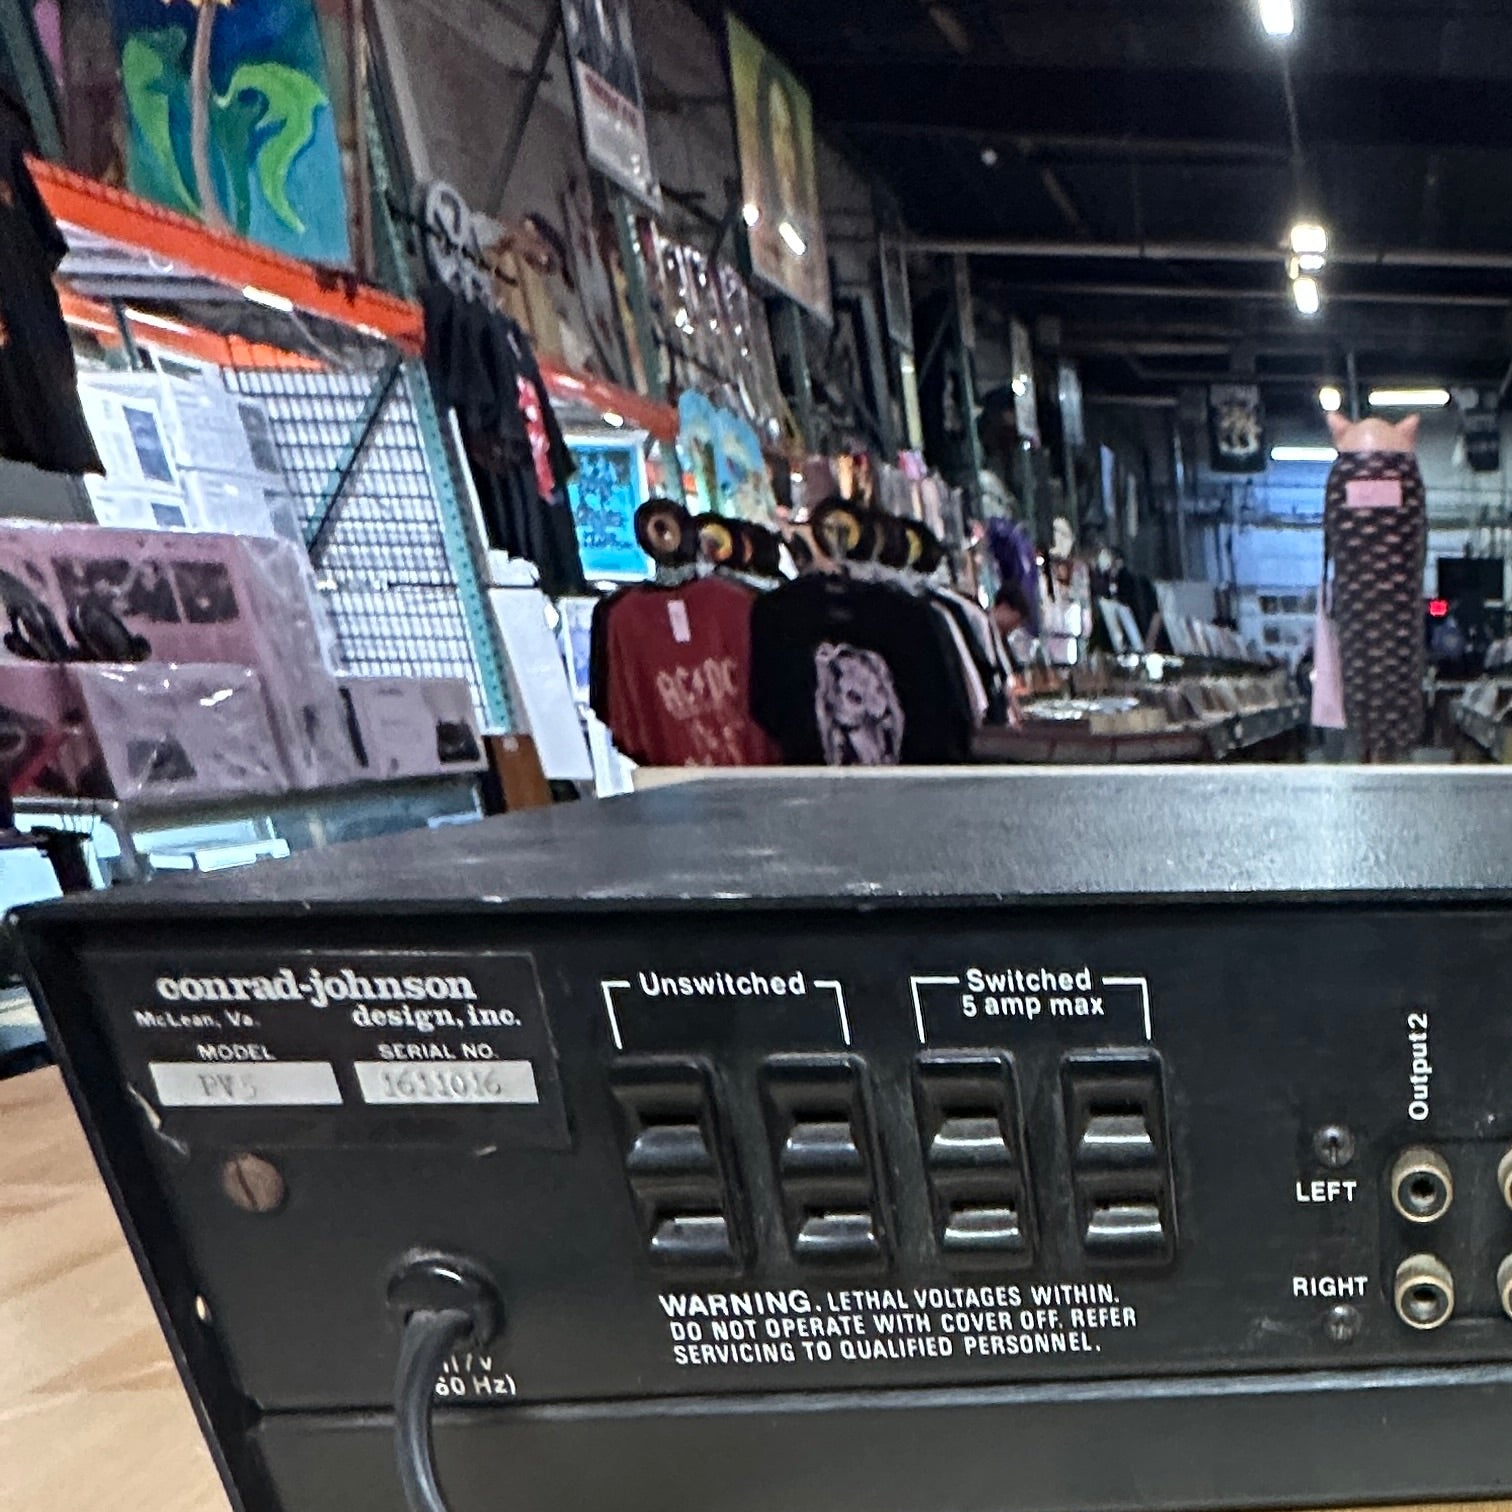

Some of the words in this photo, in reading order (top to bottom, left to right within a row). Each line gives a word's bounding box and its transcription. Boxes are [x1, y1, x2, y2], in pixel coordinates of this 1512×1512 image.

[156, 968, 478, 1007] conrad-johnson
[639, 971, 807, 996] Unswitched
[966, 967, 1092, 993] Switched
[133, 1010, 222, 1029] McLean,
[352, 1003, 464, 1033] design,
[467, 1004, 522, 1027] inc.
[962, 994, 977, 1017] 5
[985, 997, 1040, 1020] amp
[1050, 997, 1105, 1016] max
[1407, 1012, 1428, 1029] 2
[197, 1043, 276, 1061] MODEL
[377, 1043, 452, 1060] SERIAL
[461, 1043, 499, 1059] NO.
[1408, 1031, 1432, 1121] Output
[1296, 1180, 1358, 1202] LEFT
[1292, 1276, 1369, 1297] RIGHT
[658, 1289, 823, 1318] WARNING.
[826, 1288, 909, 1312] LETHAL
[913, 1286, 1022, 1309] VOLTAGES
[1030, 1283, 1120, 1306] WITHIN.
[669, 1320, 702, 1342] DO
[712, 1319, 757, 1341] NOT
[765, 1314, 866, 1338] OPERATE
[873, 1313, 931, 1334] WITH
[941, 1311, 1013, 1333] COVER
[1020, 1309, 1063, 1331] OFF.
[1070, 1306, 1137, 1328] REFER
[673, 1342, 796, 1365] SERVICING
[801, 1341, 832, 1361] TO
[839, 1336, 953, 1360] QUALIFIED
[963, 1331, 1101, 1356] PERSONNEL.
[472, 1372, 517, 1396] Hz)
